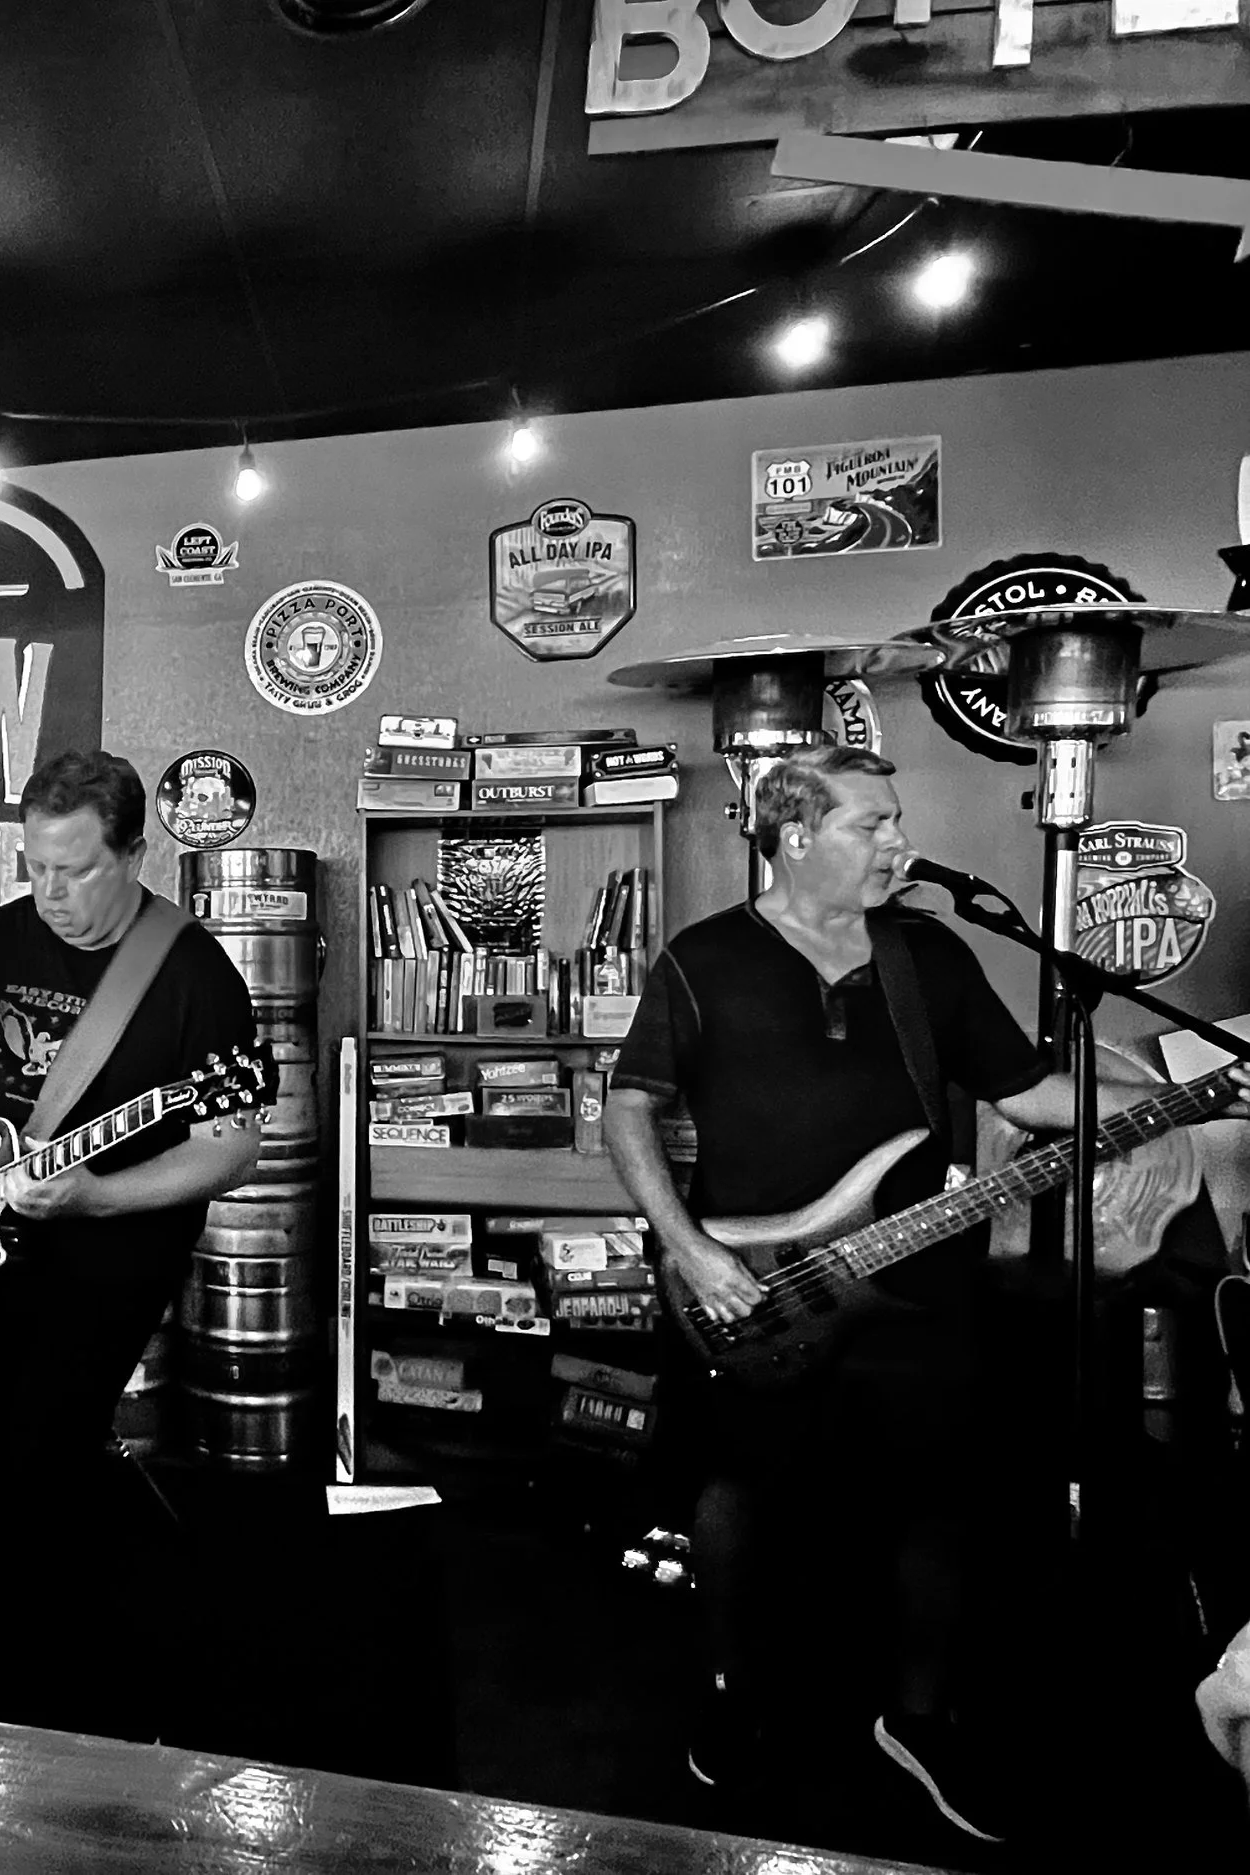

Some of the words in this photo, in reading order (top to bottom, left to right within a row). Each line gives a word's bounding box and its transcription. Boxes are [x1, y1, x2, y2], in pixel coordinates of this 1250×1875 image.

[769, 476, 807, 496] 101
[847, 458, 916, 492] MOUNTAIN
[183, 536, 212, 546] LEFT
[508, 546, 542, 569] ALL
[546, 542, 578, 561] DAY
[585, 541, 612, 560] IPA
[266, 597, 316, 639] PIZZA
[325, 598, 363, 637] PORT
[524, 620, 575, 635] SESSION
[578, 618, 600, 632] ALE
[266, 660, 311, 696] BREWING
[314, 653, 362, 694] COMPANY
[478, 784, 556, 799] OUTBURST
[1077, 837, 1112, 854] KARL
[1114, 832, 1175, 852] STRAUSS
[1115, 917, 1183, 970] IPA
[372, 1127, 448, 1142] SEQUENCE
